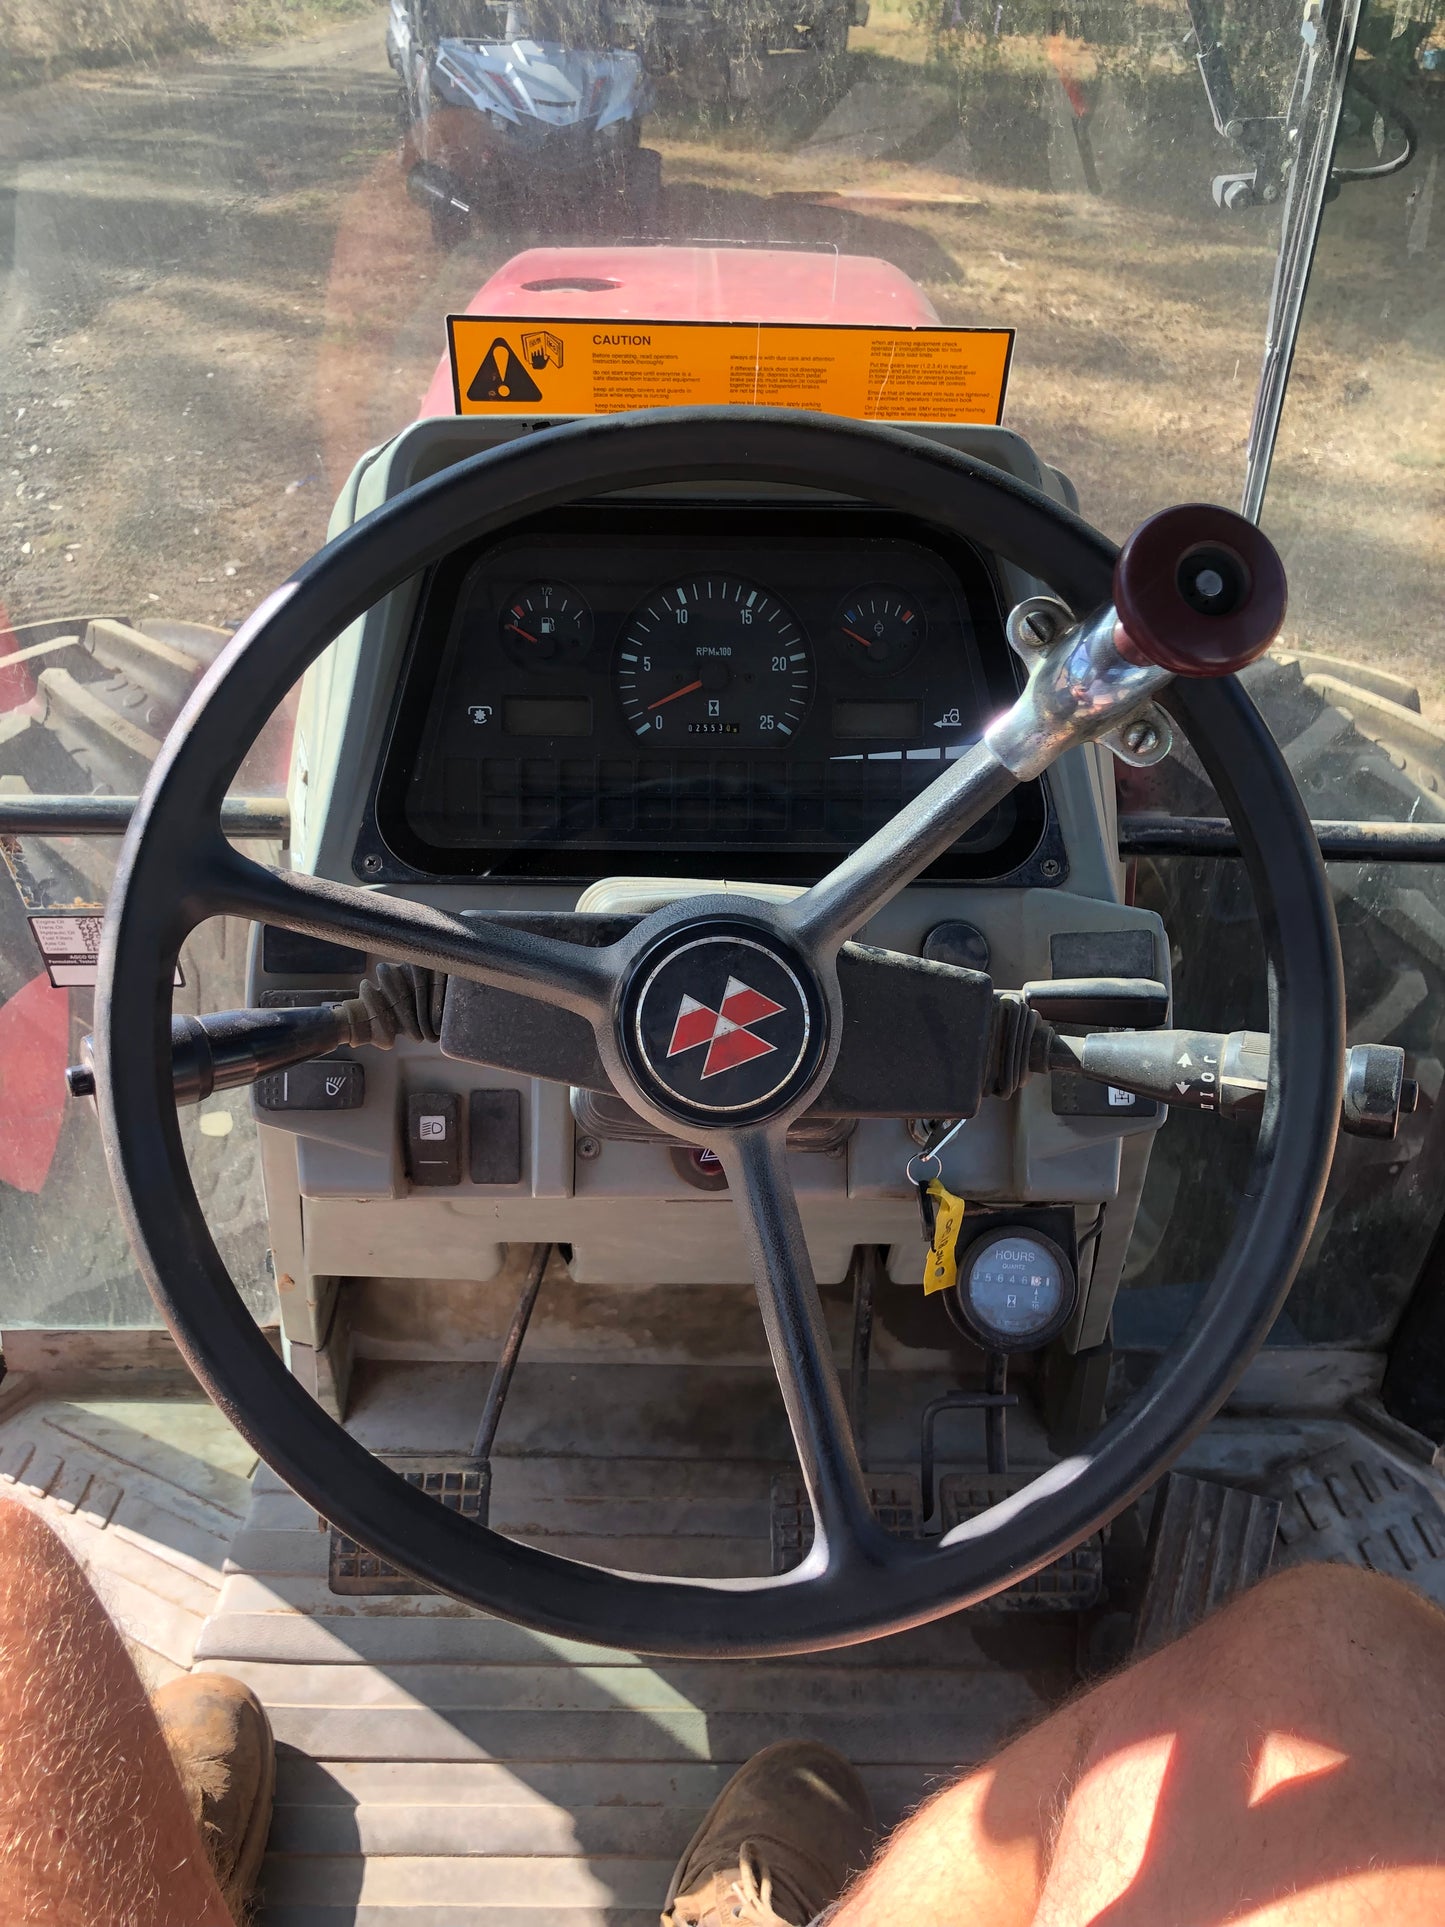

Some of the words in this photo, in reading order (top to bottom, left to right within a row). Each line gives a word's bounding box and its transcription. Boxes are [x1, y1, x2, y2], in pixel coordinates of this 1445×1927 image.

[592, 335, 651, 345] CAUTION
[541, 587, 553, 596] 1/2
[675, 609, 688, 624] 10
[740, 609, 753, 625] 15
[643, 656, 651, 672] 5
[772, 656, 787, 672] 20
[655, 715, 663, 730] 0
[759, 715, 774, 730] 25
[995, 1250, 1035, 1262] HOURS
